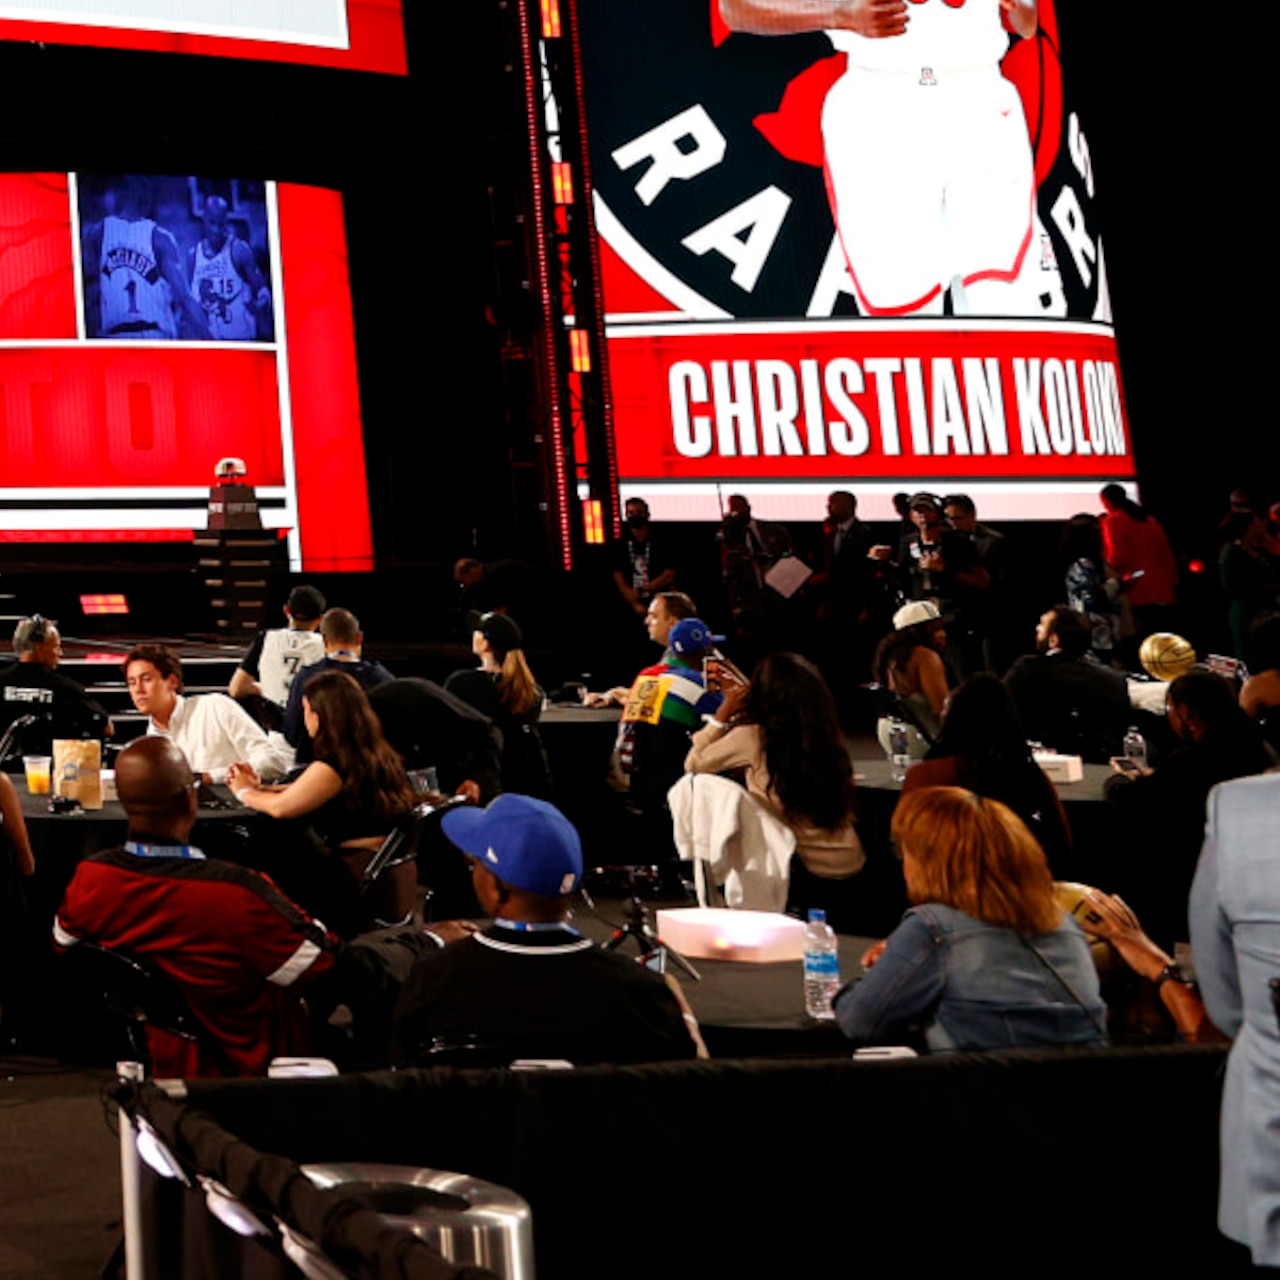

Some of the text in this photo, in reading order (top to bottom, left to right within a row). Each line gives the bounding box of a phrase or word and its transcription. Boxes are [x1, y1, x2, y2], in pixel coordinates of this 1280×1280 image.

[124, 280, 141, 314] 1
[668, 357, 1009, 460] CHRISTIAN
[4, 685, 53, 703] ESPN
